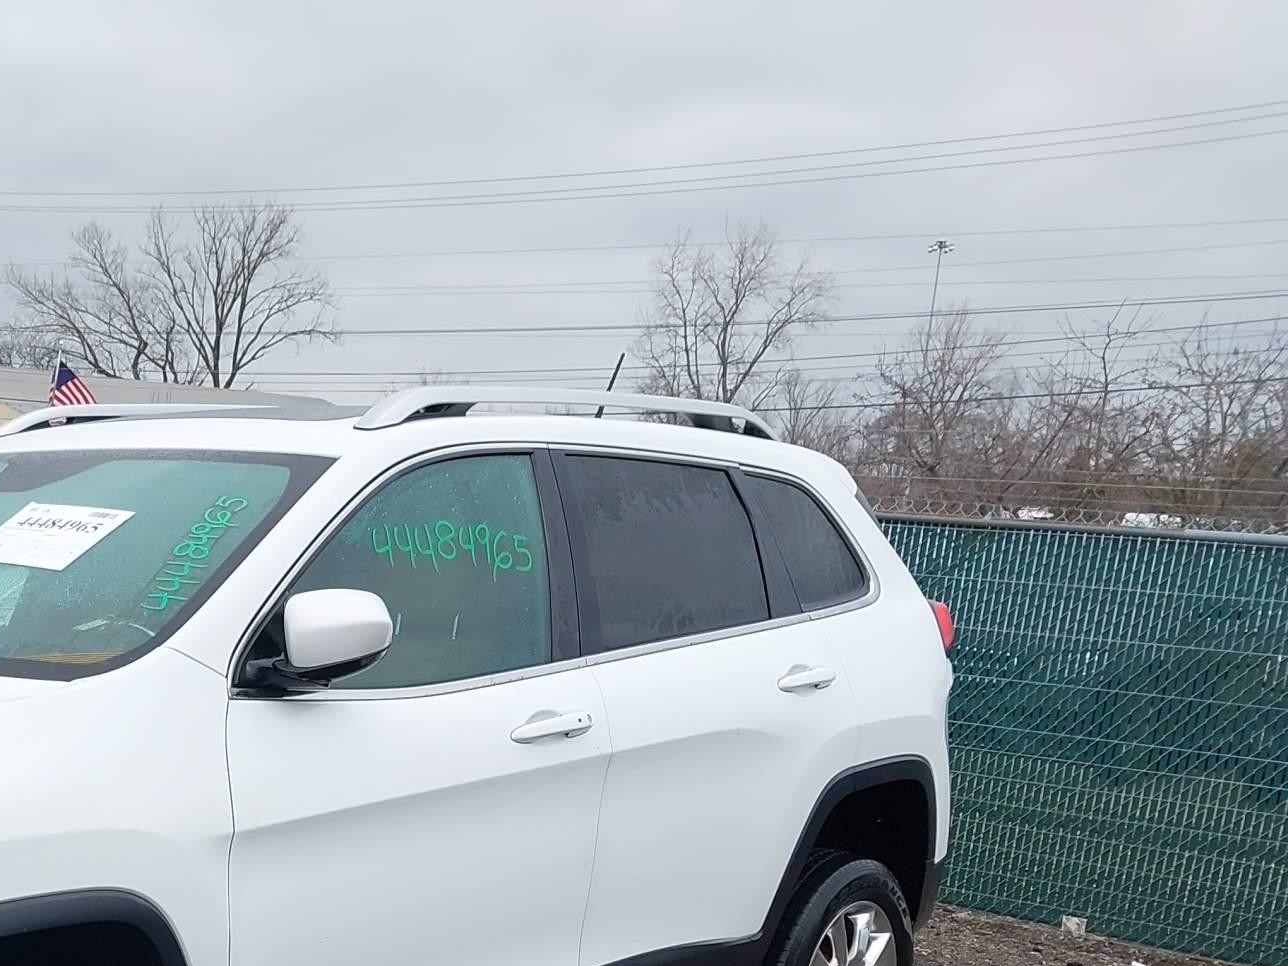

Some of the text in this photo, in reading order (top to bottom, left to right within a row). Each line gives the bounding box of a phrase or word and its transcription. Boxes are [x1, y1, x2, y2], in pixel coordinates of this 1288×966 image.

[17, 516, 105, 533] 44484965
[140, 496, 248, 610] 44484965
[372, 520, 532, 582] 44484965
